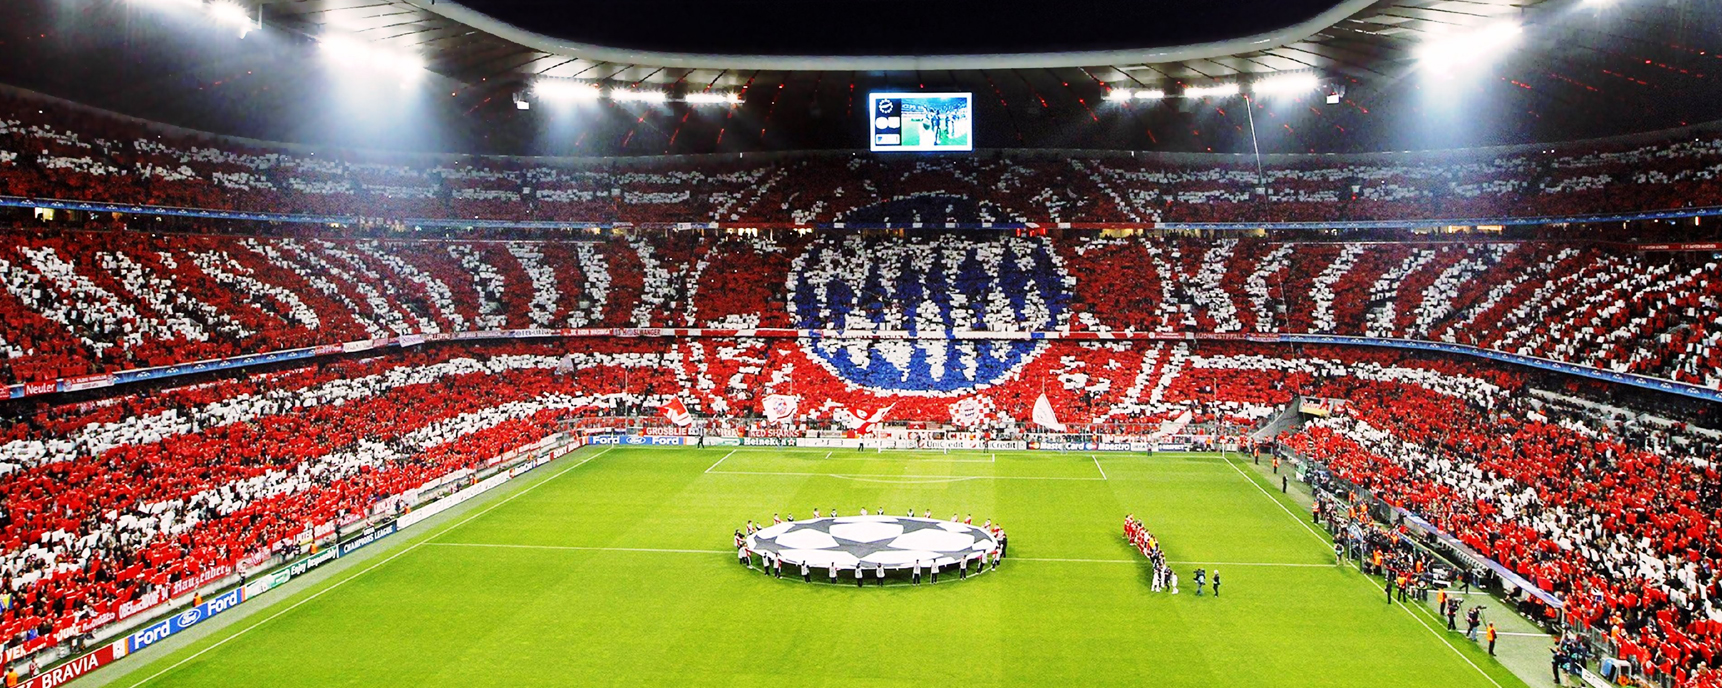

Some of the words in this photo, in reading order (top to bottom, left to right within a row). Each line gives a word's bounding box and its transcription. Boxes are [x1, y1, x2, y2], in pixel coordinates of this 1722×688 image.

[26, 384, 55, 395] Neuler
[593, 436, 620, 444] Ford
[652, 436, 679, 445] Ford
[744, 438, 786, 446] Heinekn
[978, 441, 1016, 449] UiCredit
[1040, 440, 1084, 450] MasteCard
[1098, 442, 1130, 450] Maestro
[343, 534, 374, 553] CHAMPIONS
[374, 525, 393, 540] LEAGUE
[291, 563, 307, 576] Enjoy
[307, 546, 337, 569] Responsibly
[207, 590, 238, 616] Ford
[134, 619, 171, 650] Ford
[41, 653, 99, 688] BRAVIA
